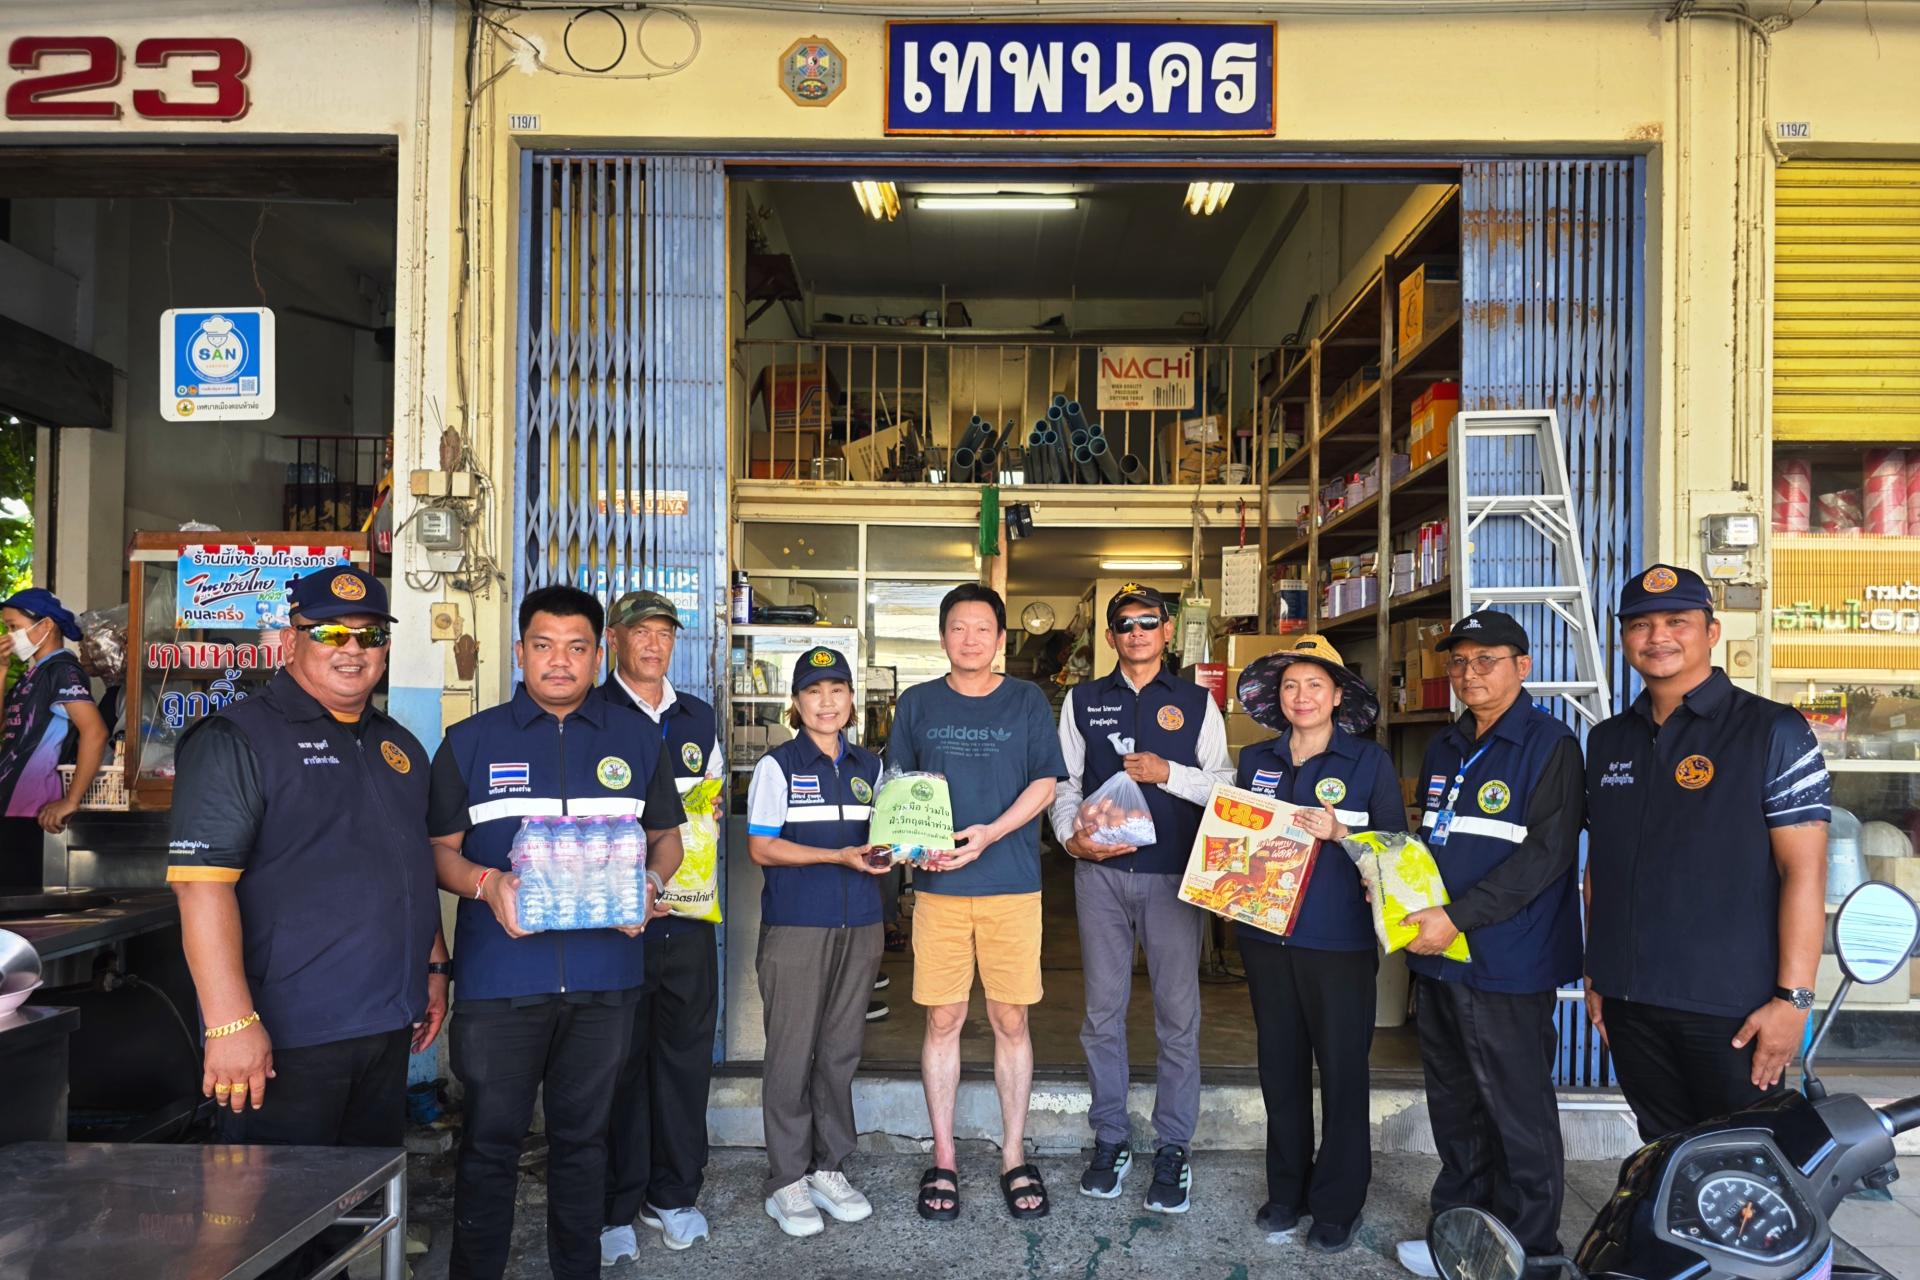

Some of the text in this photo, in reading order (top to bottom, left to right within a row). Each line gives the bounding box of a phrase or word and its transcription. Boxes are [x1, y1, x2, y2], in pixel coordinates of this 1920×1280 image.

[6, 36, 252, 120] 23
[904, 41, 1257, 114] เทพนคร
[511, 115, 537, 129] 119/1
[1780, 123, 1808, 137] 119/2
[198, 347, 236, 361] SAN
[194, 549, 336, 567] ร้านนี้เข้าร่วมโครงการ
[184, 605, 244, 621] คนละครึ่ง
[162, 668, 248, 729] ลูกชิ้
[927, 725, 989, 741] adidas
